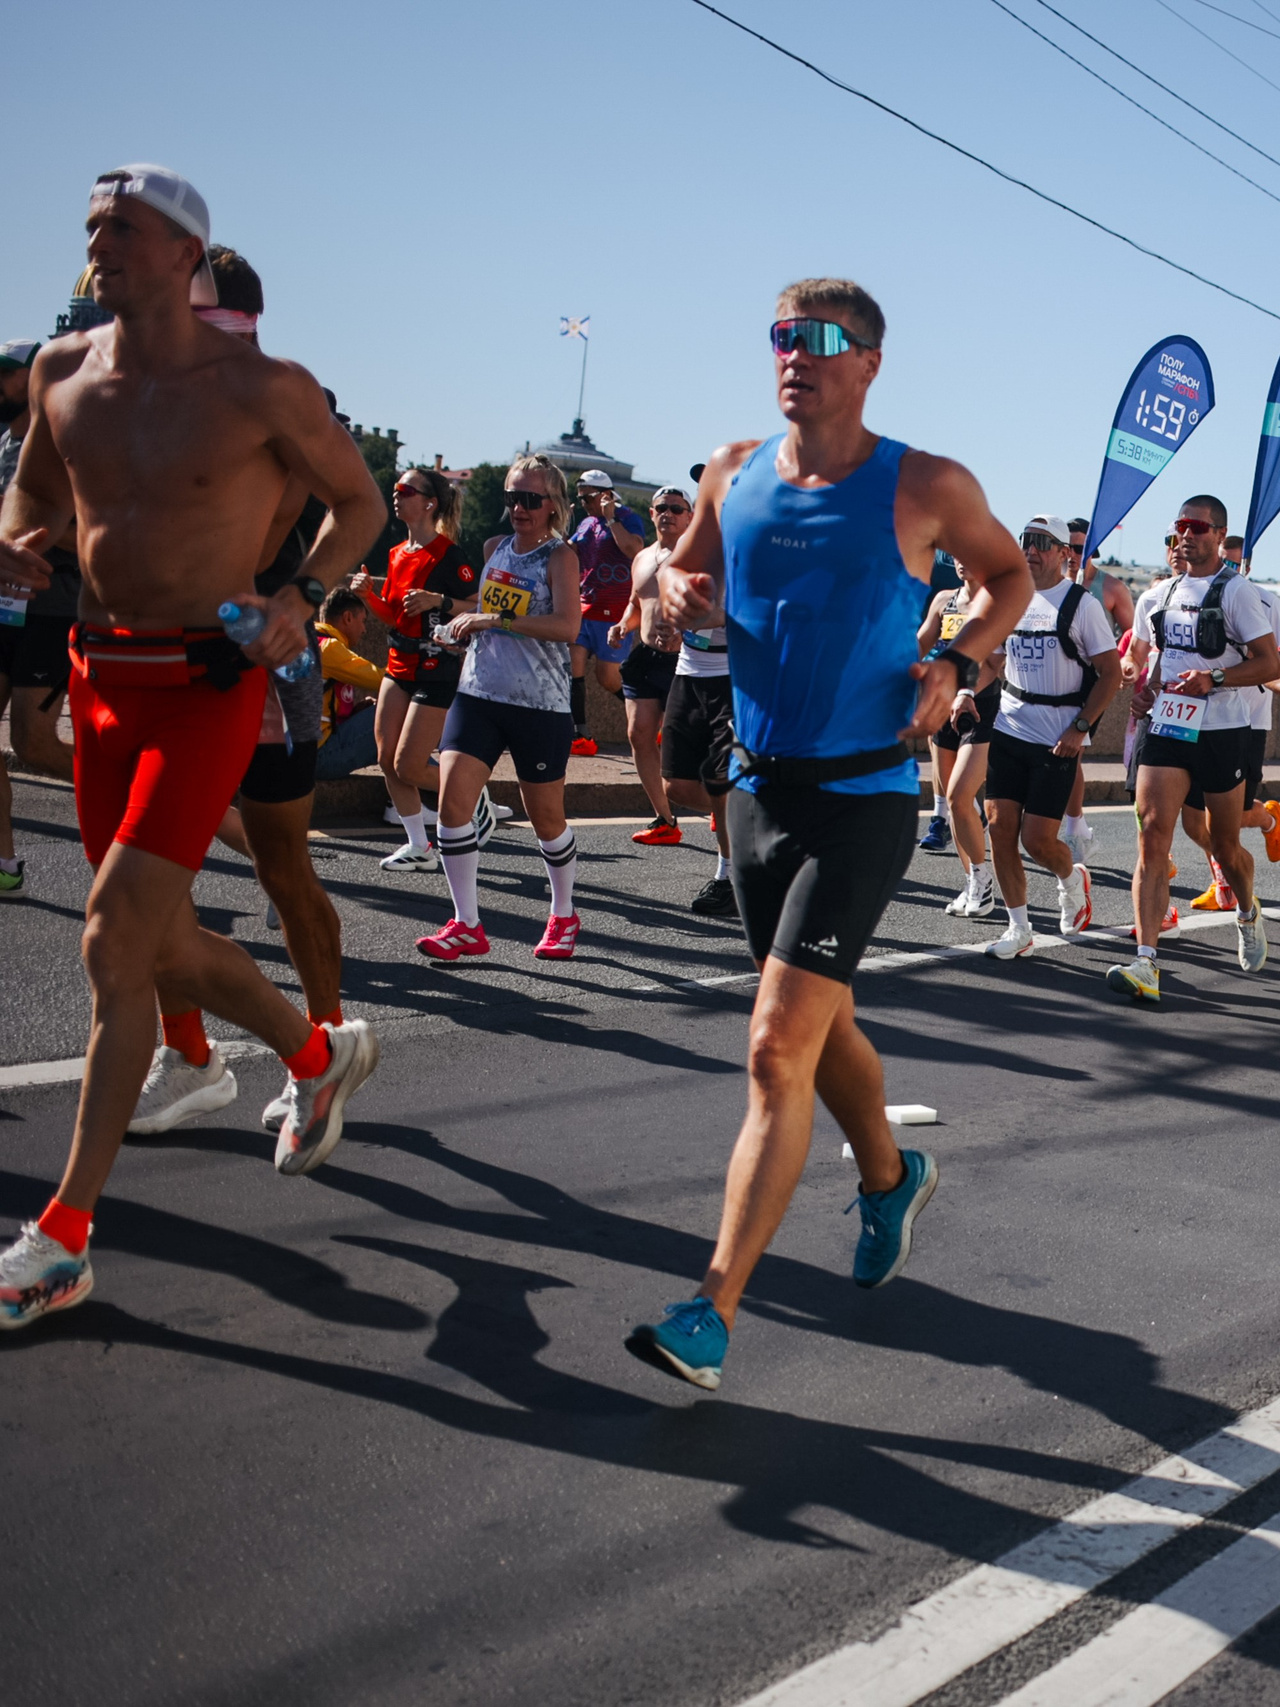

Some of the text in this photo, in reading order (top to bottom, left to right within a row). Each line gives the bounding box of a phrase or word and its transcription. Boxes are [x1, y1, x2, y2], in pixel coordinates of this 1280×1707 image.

[1160, 353, 1184, 370] ПОЛУ
[1158, 364, 1200, 390] МАРАФОН
[1135, 389, 1186, 441] 1:59
[1117, 439, 1142, 461] 5:38
[484, 586, 522, 611] 4567
[947, 618, 964, 632] 29
[1011, 636, 1044, 659] 1:59
[1160, 700, 1197, 721] 7617
